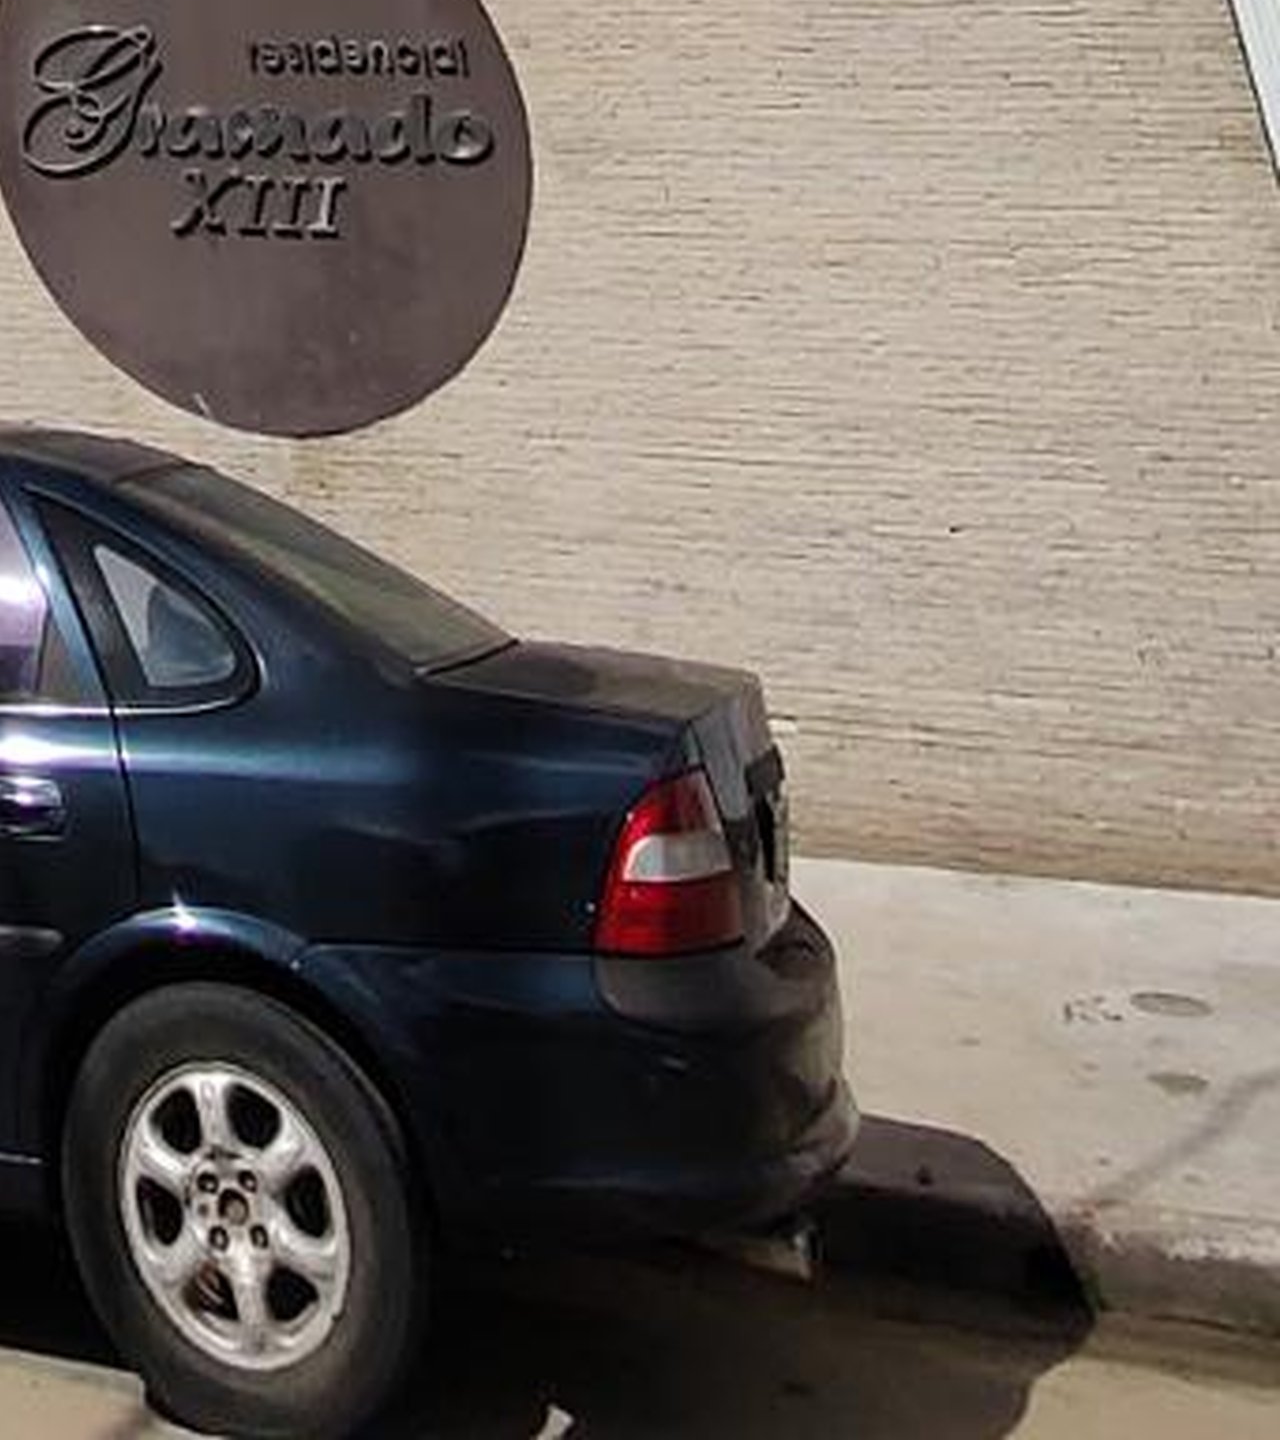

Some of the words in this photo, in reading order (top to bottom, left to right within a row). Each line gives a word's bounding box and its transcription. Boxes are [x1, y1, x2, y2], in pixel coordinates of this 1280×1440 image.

[250, 34, 471, 79] residencial
[22, 24, 495, 178] Gramado
[170, 168, 347, 239] XIII
